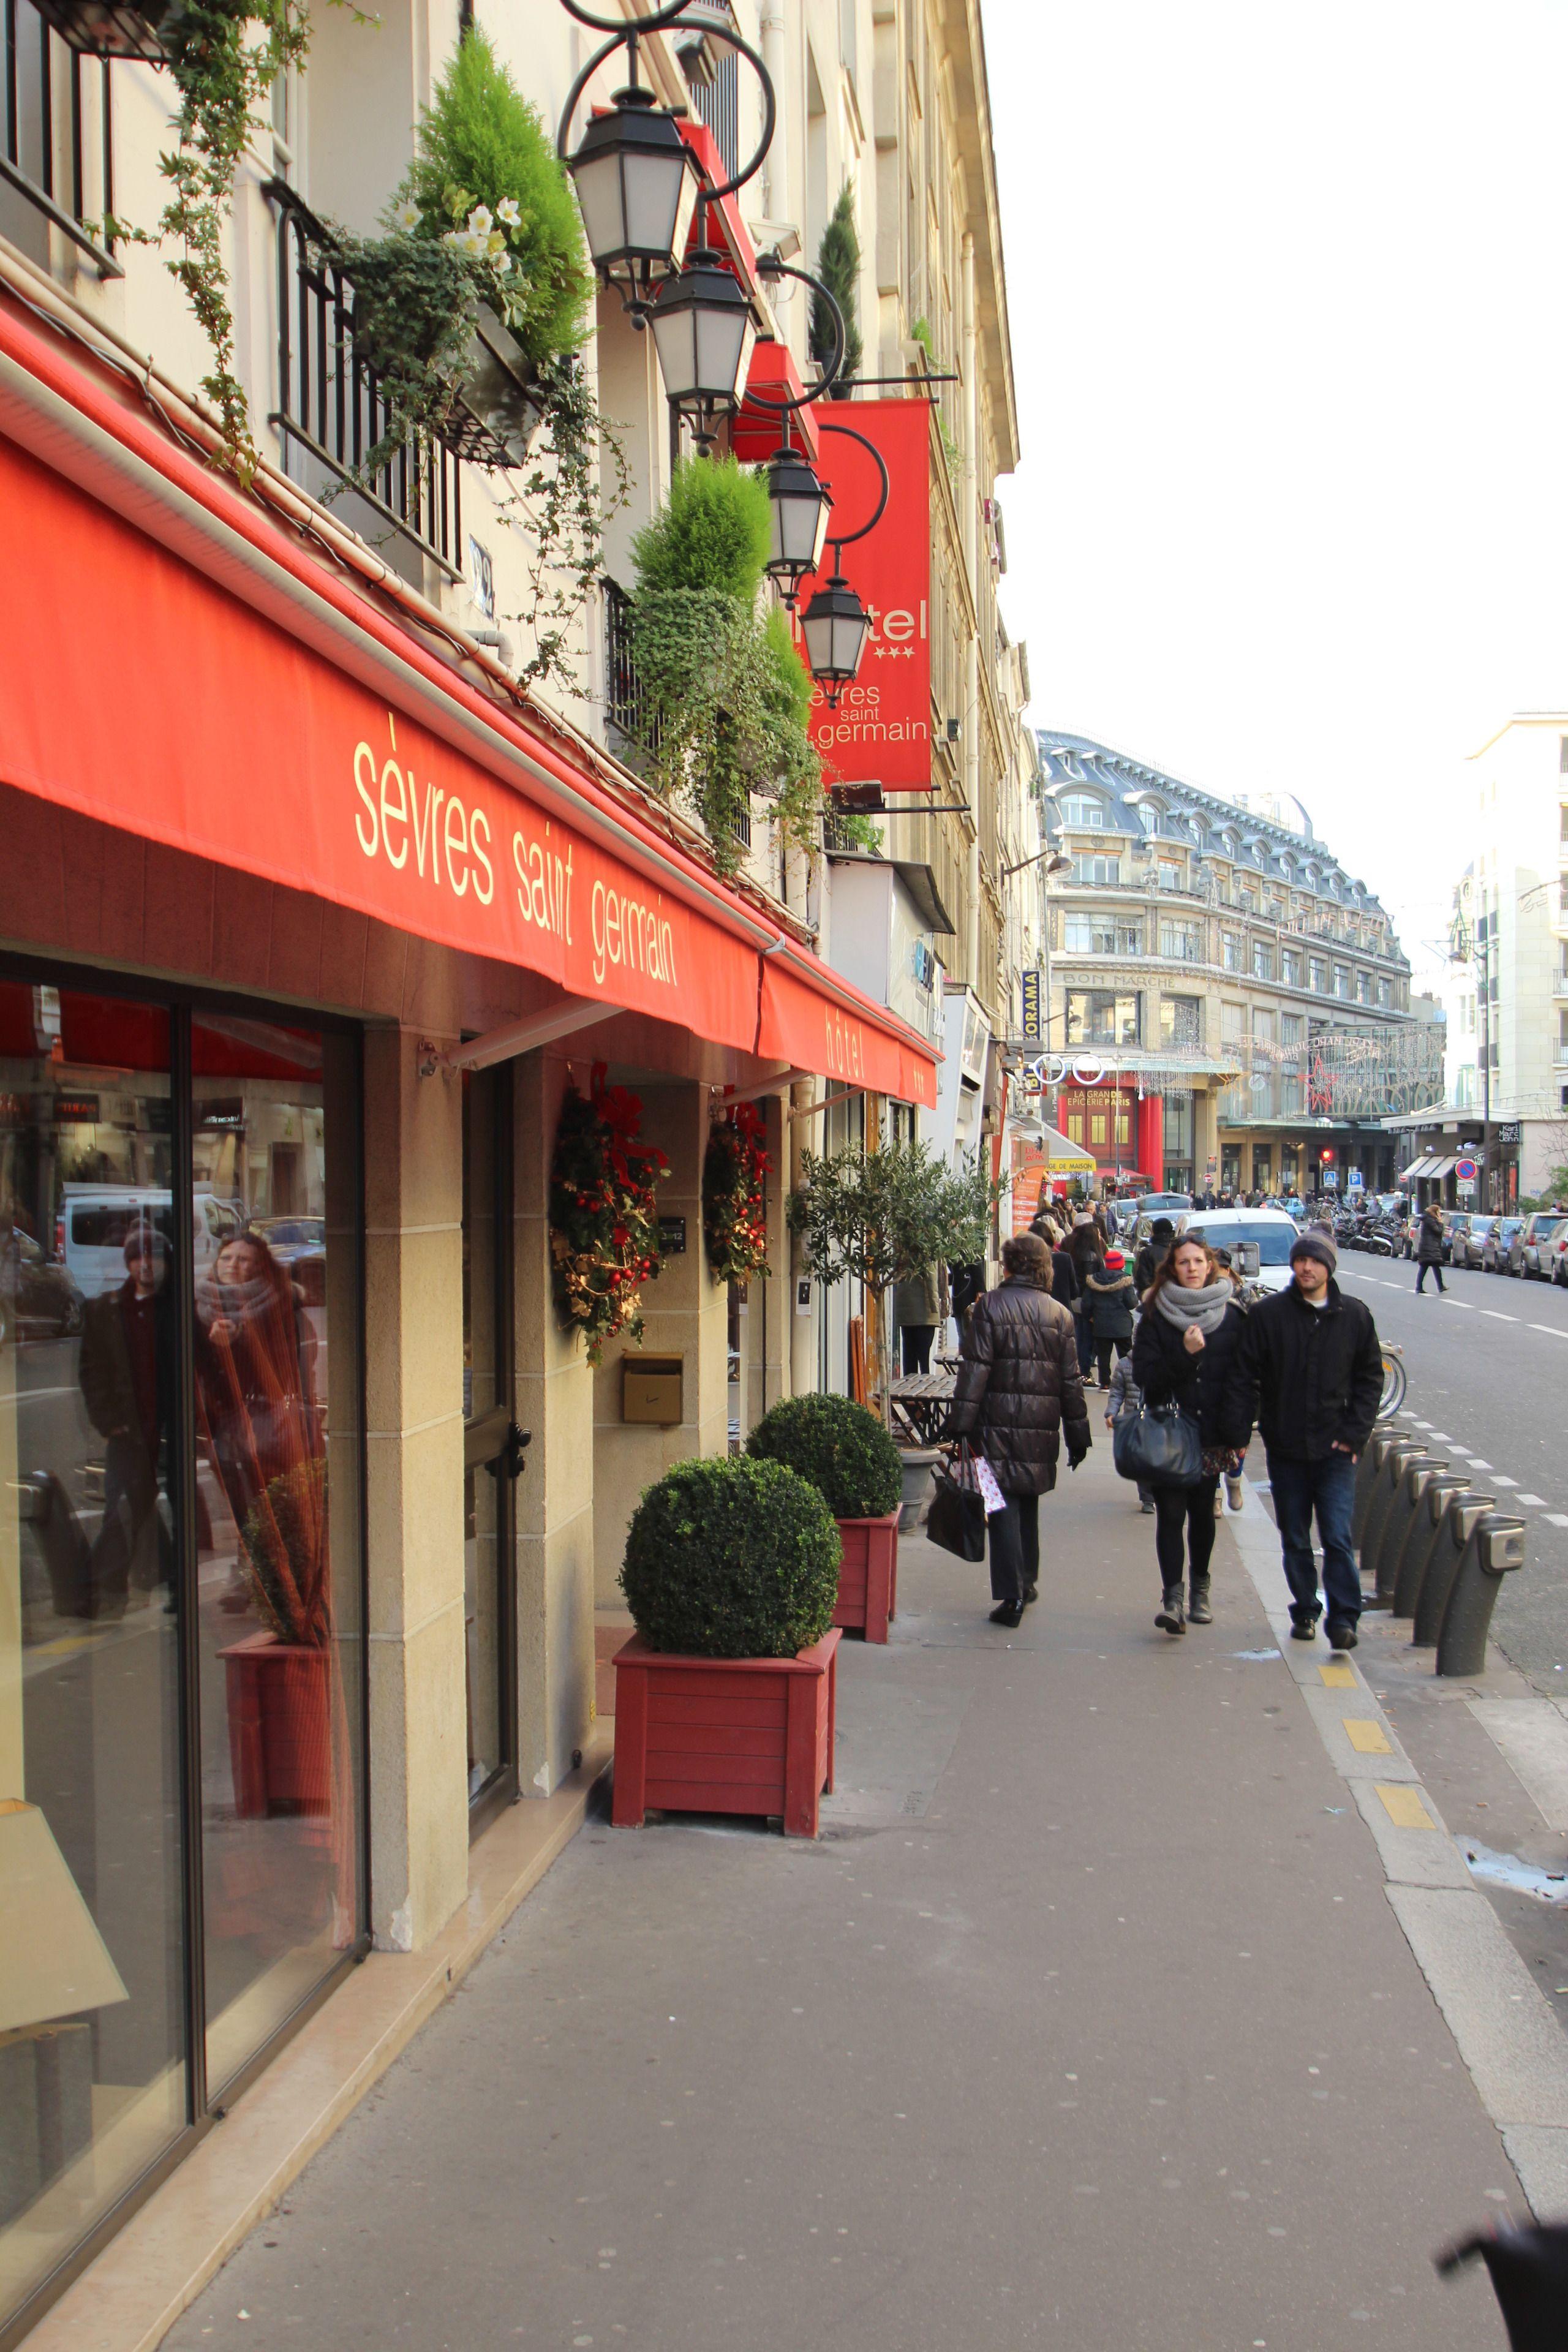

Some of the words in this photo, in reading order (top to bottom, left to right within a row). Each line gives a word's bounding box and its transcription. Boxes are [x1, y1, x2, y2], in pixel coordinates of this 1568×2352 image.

[840, 706, 880, 722] saint
[818, 717, 927, 750] germain
[353, 712, 494, 906] sèvres
[513, 821, 573, 946] saint
[590, 894, 677, 985] germain
[1063, 973, 1105, 984] BON
[825, 1005, 865, 1079] hôtel
[1351, 1175, 1358, 1183] P
